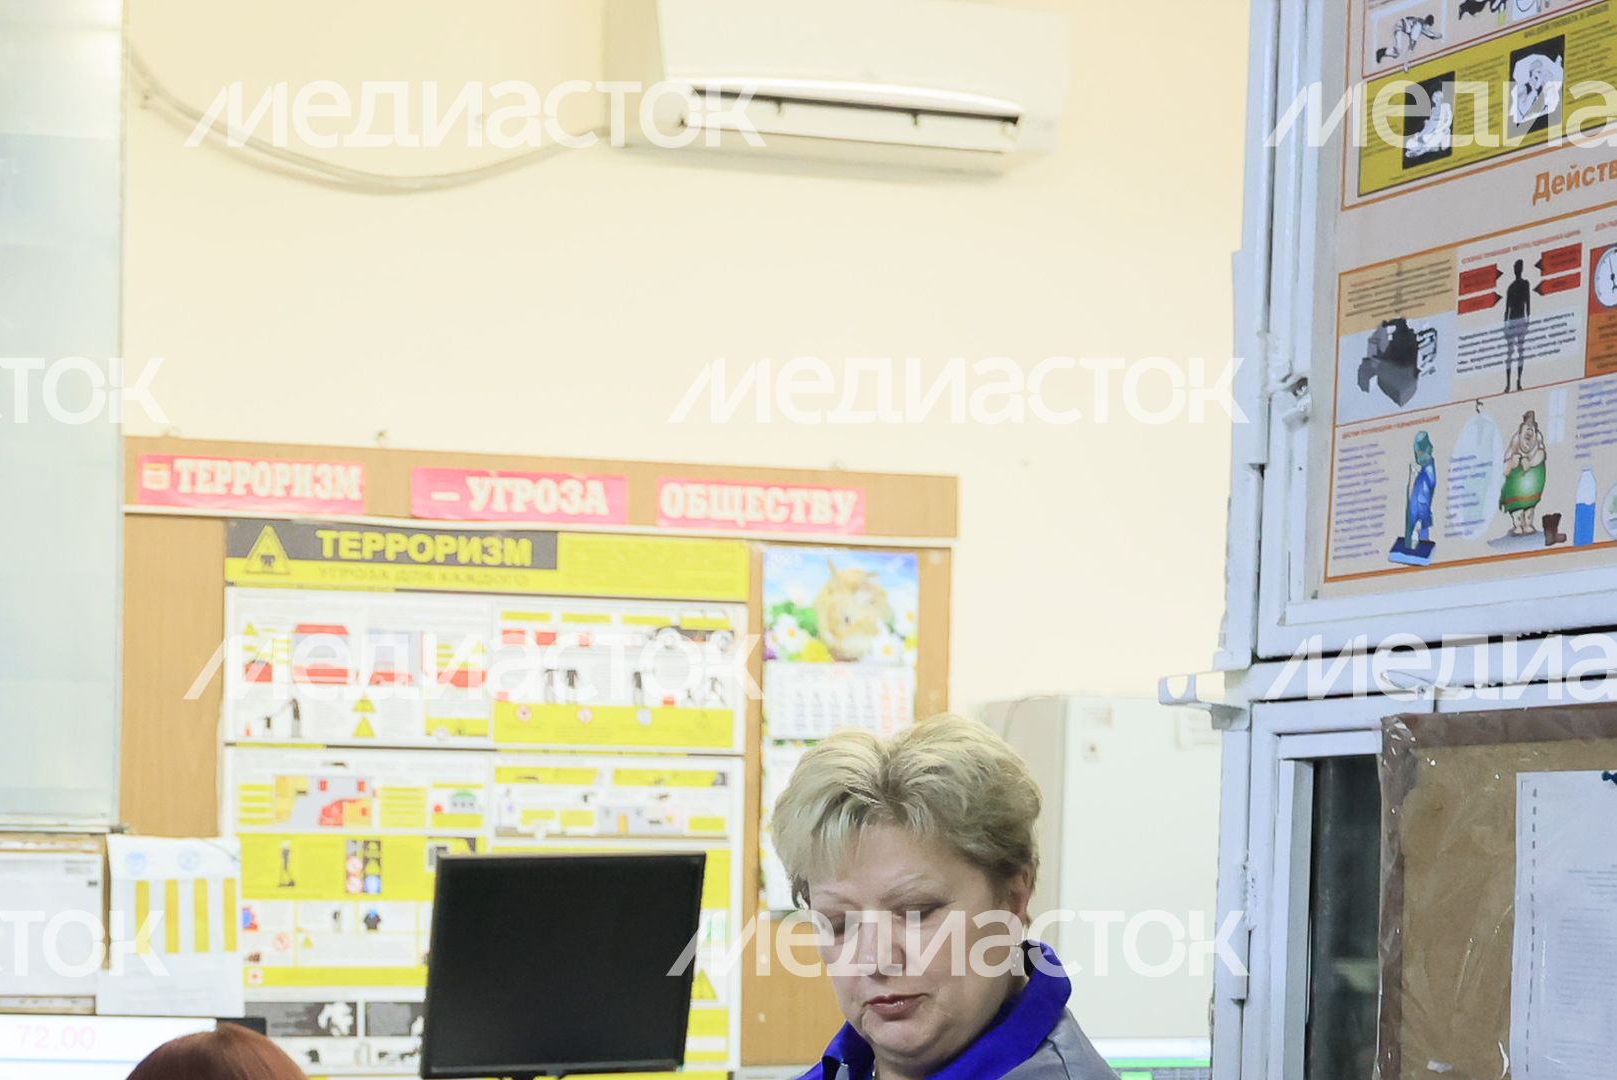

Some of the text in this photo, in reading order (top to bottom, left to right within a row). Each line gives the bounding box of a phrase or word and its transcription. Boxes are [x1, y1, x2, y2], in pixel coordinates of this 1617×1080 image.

[173, 458, 364, 501] ТЕРРОРИЗМ
[466, 474, 610, 517] УГРОЗА
[659, 481, 858, 527] ОБЩЕСТВУ
[315, 529, 533, 568] ТЕРРОРИЗМ
